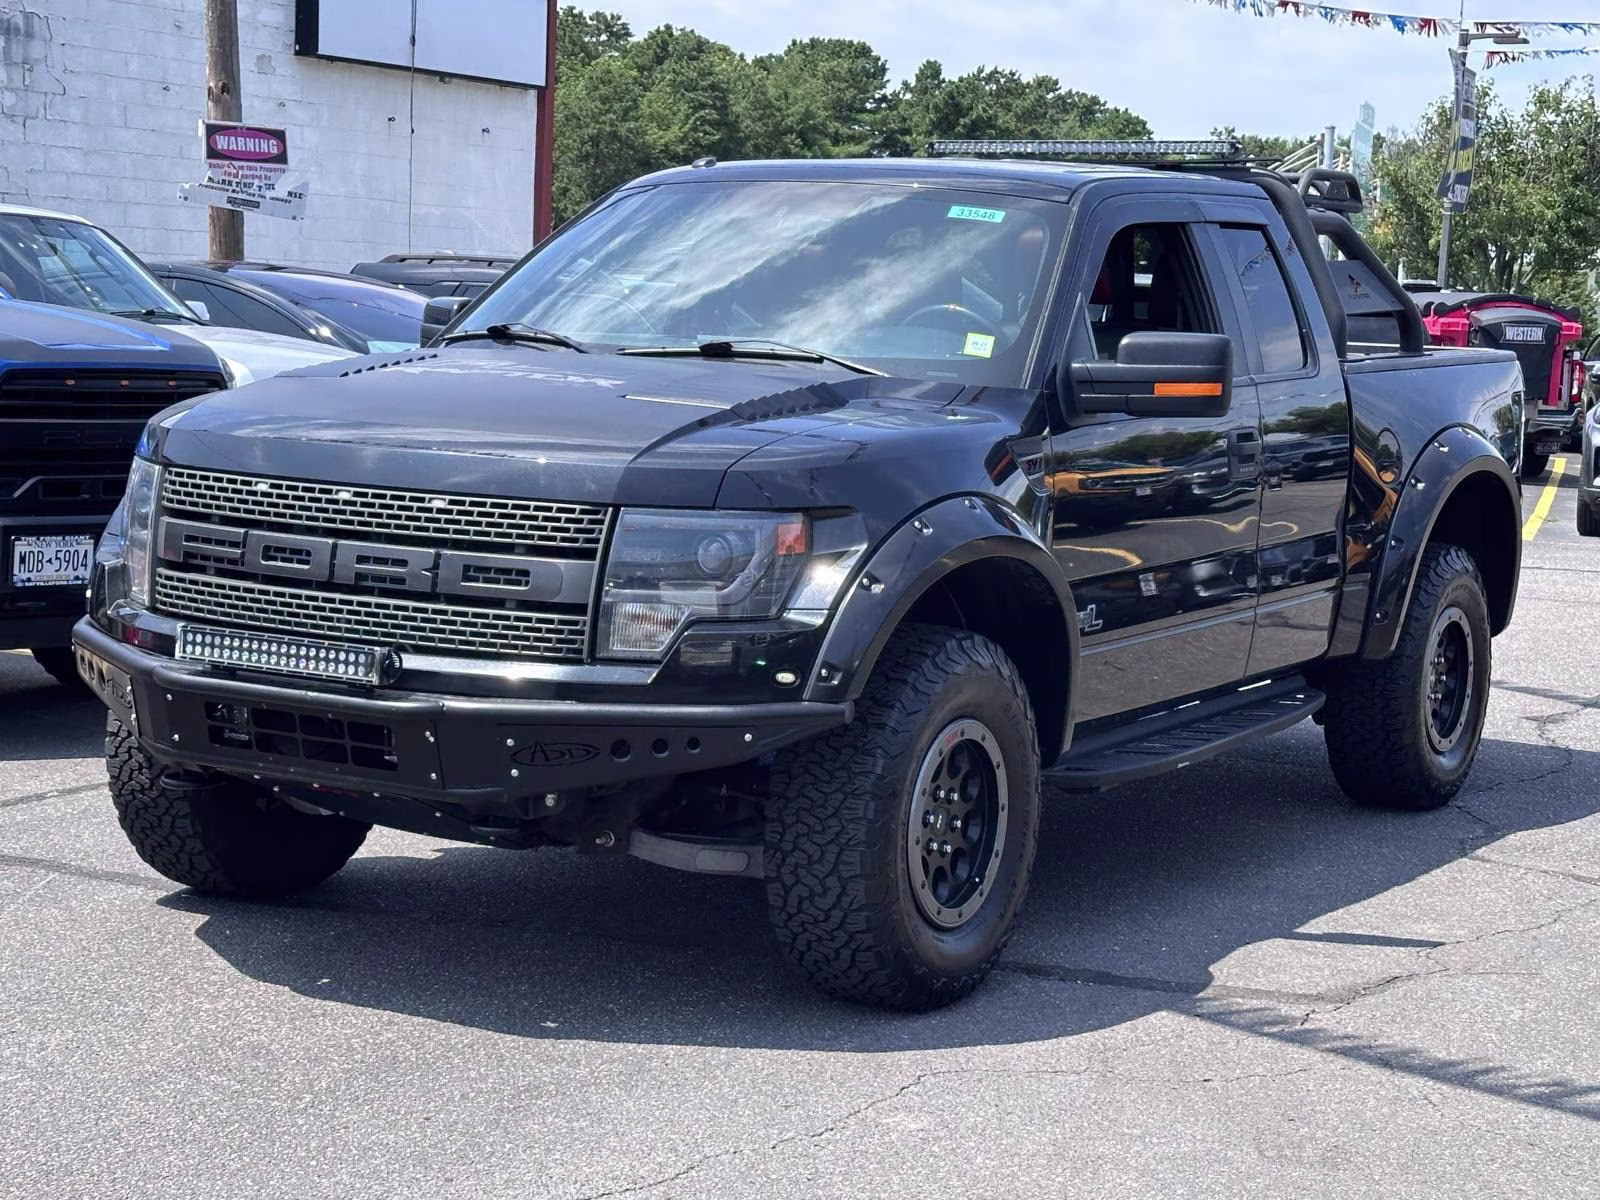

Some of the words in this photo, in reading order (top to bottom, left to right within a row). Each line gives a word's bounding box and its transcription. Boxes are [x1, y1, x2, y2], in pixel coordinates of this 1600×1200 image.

[215, 134, 278, 154] WARNING
[956, 207, 997, 220] 33548
[1505, 325, 1544, 341] WESTERN
[33, 540, 52, 549] NEW
[54, 540, 75, 548] YORK
[18, 550, 44, 574] MDB
[54, 549, 89, 573] 5904
[157, 515, 564, 601] FORD
